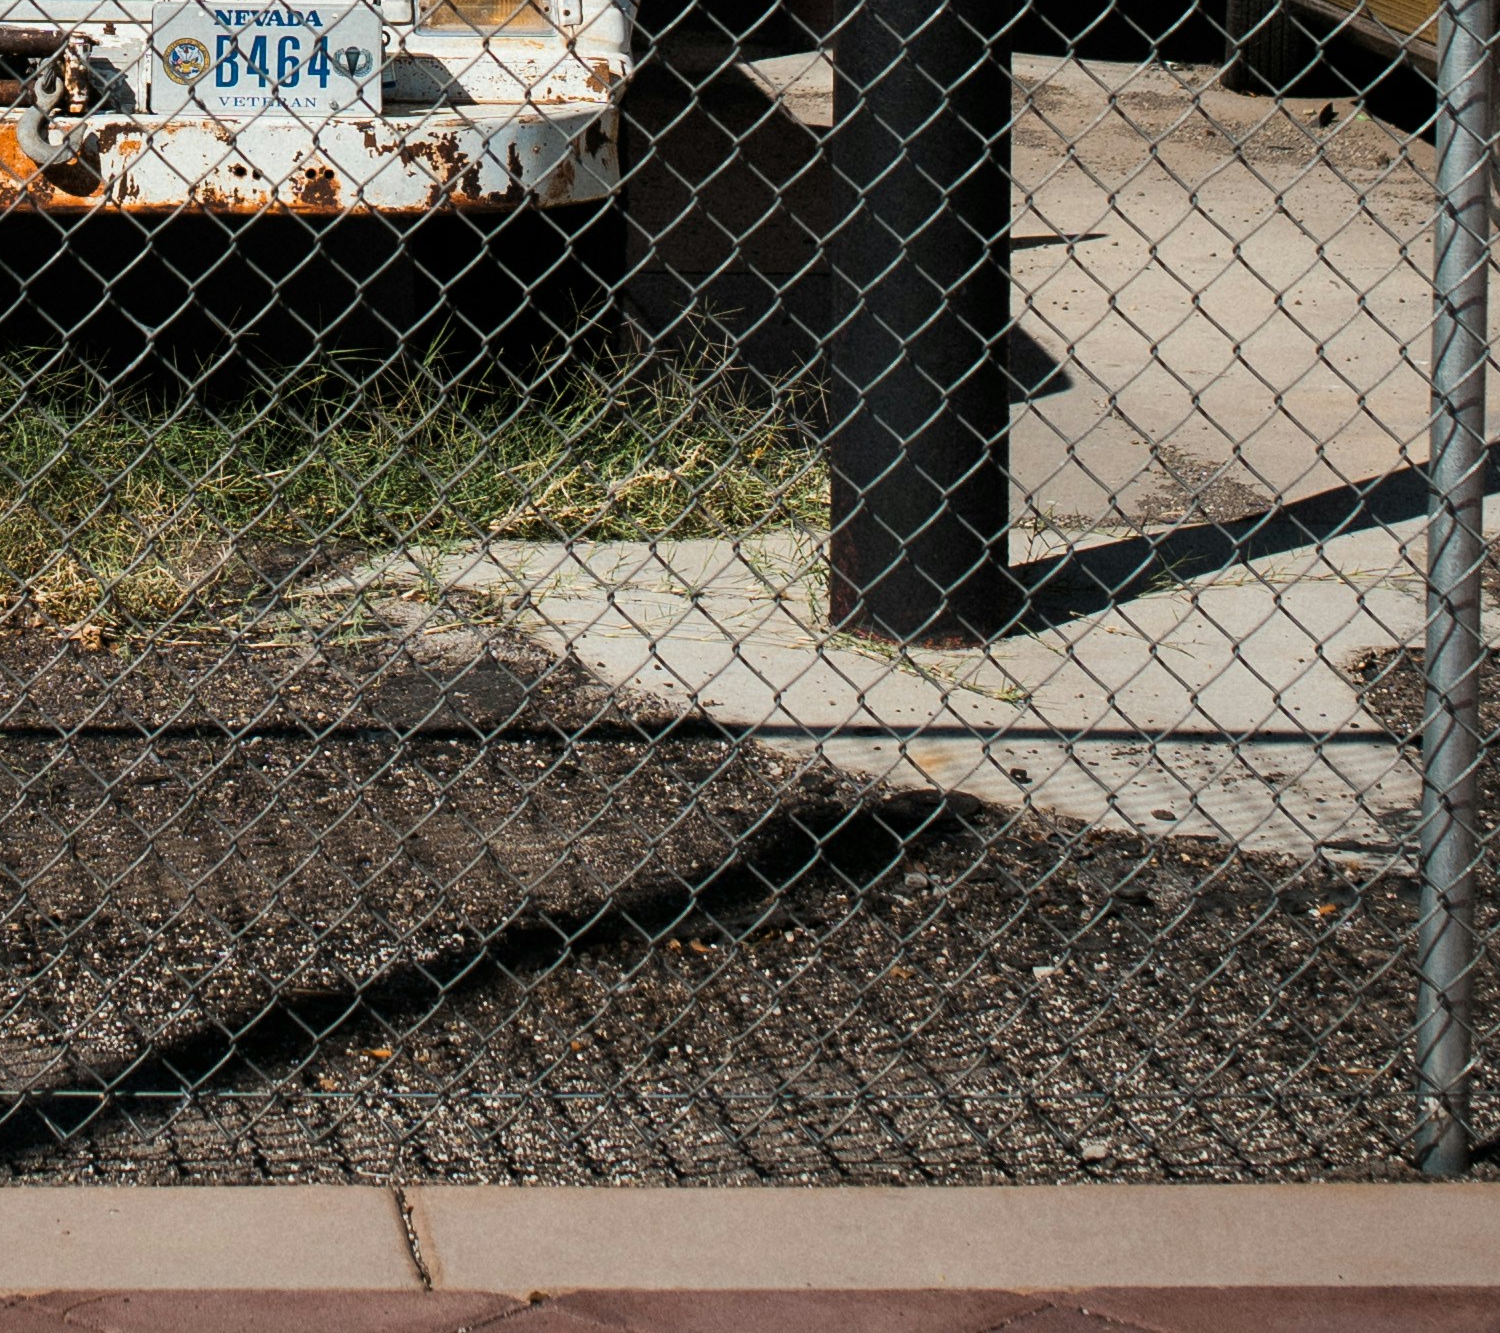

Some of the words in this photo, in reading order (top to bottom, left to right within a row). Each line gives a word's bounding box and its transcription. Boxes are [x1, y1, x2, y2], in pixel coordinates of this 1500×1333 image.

[213, 9, 323, 27] NEVADA
[214, 34, 331, 89] B464
[218, 95, 318, 108] VETERAN
